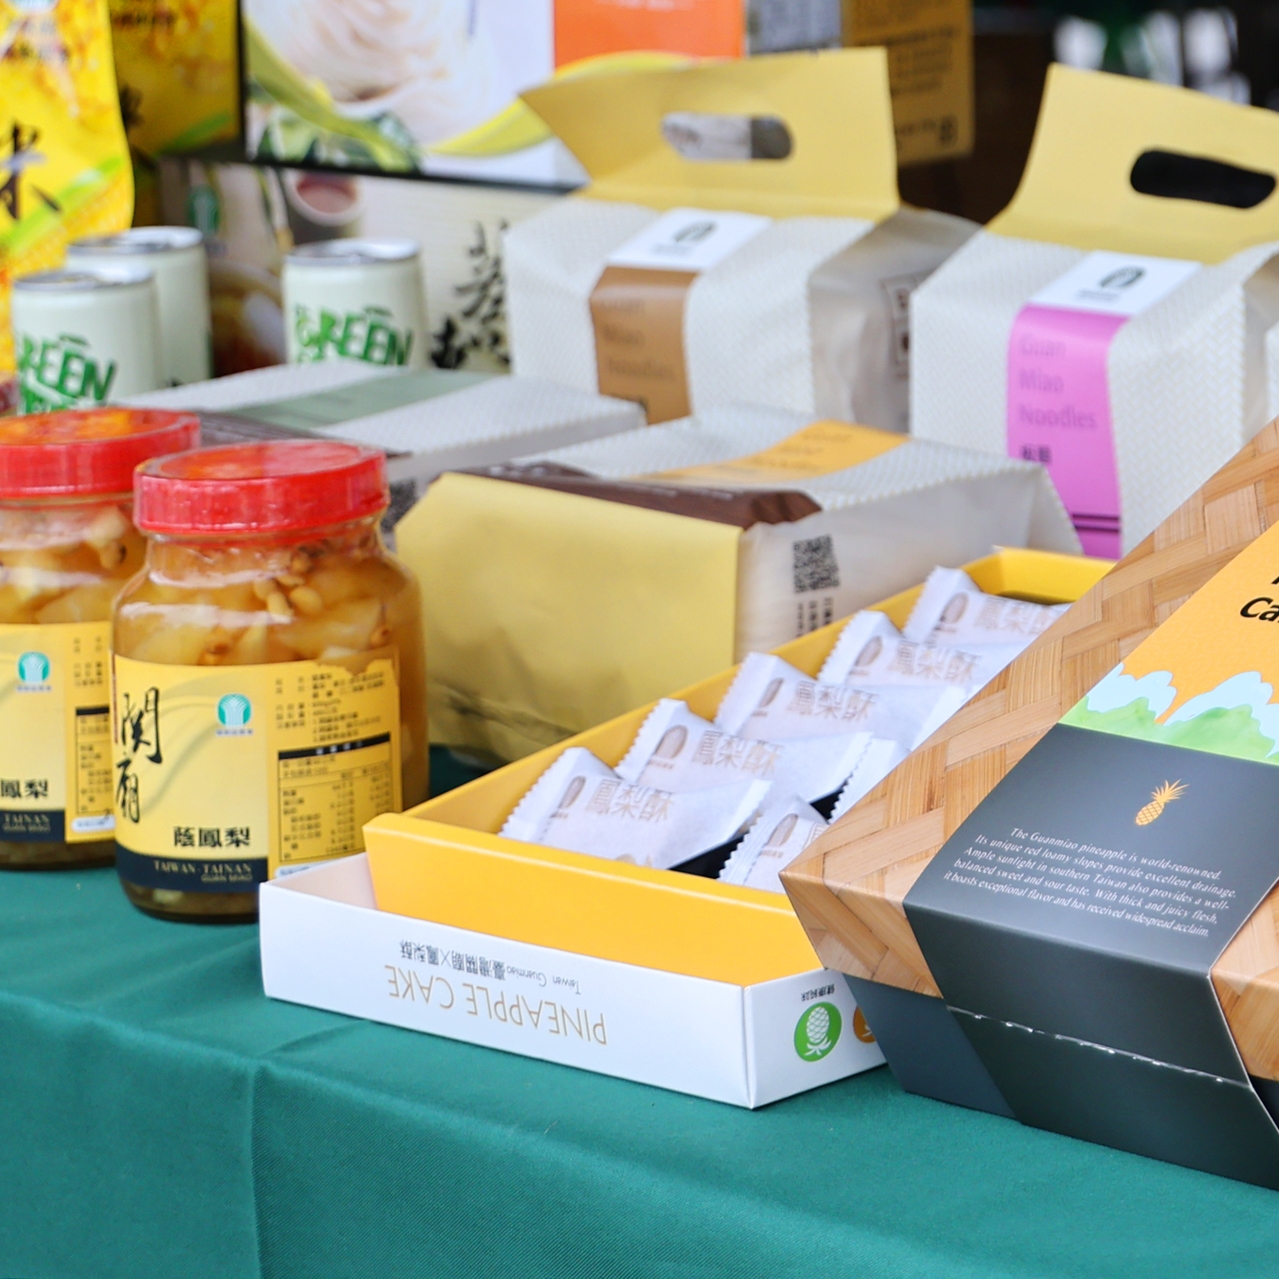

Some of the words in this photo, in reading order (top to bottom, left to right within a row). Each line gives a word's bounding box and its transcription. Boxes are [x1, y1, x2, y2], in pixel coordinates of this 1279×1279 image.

[1018, 404, 1098, 429] Noodles
[585, 777, 675, 823] 鳳梨酥
[173, 826, 251, 848] 蔭鳳梨
[1010, 827, 1028, 839] The
[1030, 831, 1078, 850] Guanmiao
[1078, 843, 1127, 861] pineapple
[1140, 856, 1222, 880] world-renowned.
[964, 847, 996, 860] Ample
[997, 855, 1036, 869] sunlight
[1049, 866, 1090, 881] southern
[1093, 874, 1127, 889] Taiwan
[1128, 882, 1150, 893] also
[1149, 888, 1193, 903] provides
[1204, 900, 1230, 910] well-
[975, 834, 988, 844] Its
[990, 840, 1023, 852] unique
[1024, 846, 1040, 856] red
[1042, 849, 1072, 863] loamy
[1073, 856, 1103, 869] slopes
[1104, 864, 1144, 878] provide
[1145, 872, 1191, 888] excellent
[1192, 881, 1236, 898] drainage.
[951, 871, 978, 886] boasts
[978, 880, 1028, 894] exceptional
[1027, 889, 1055, 902] flavor
[1053, 897, 1072, 907] and
[1070, 898, 1085, 910] has
[1086, 904, 1126, 918] received
[1125, 909, 1175, 927] widespread
[1173, 924, 1209, 937] acclaim.
[953, 858, 997, 875] balanced
[996, 869, 1025, 881] sweet
[1023, 876, 1044, 886] and
[1044, 879, 1065, 890] sour
[1065, 883, 1090, 896] taste.
[1095, 888, 1118, 902] With
[1118, 894, 1143, 907] thick
[1145, 902, 1166, 911] and
[1162, 905, 1190, 919] juicy
[1191, 909, 1218, 924] flesh,
[384, 964, 454, 1009] CAKE
[506, 965, 548, 987] Guanmiao
[552, 975, 581, 995] Taiwan
[462, 982, 607, 1045] PINEAPPLE
